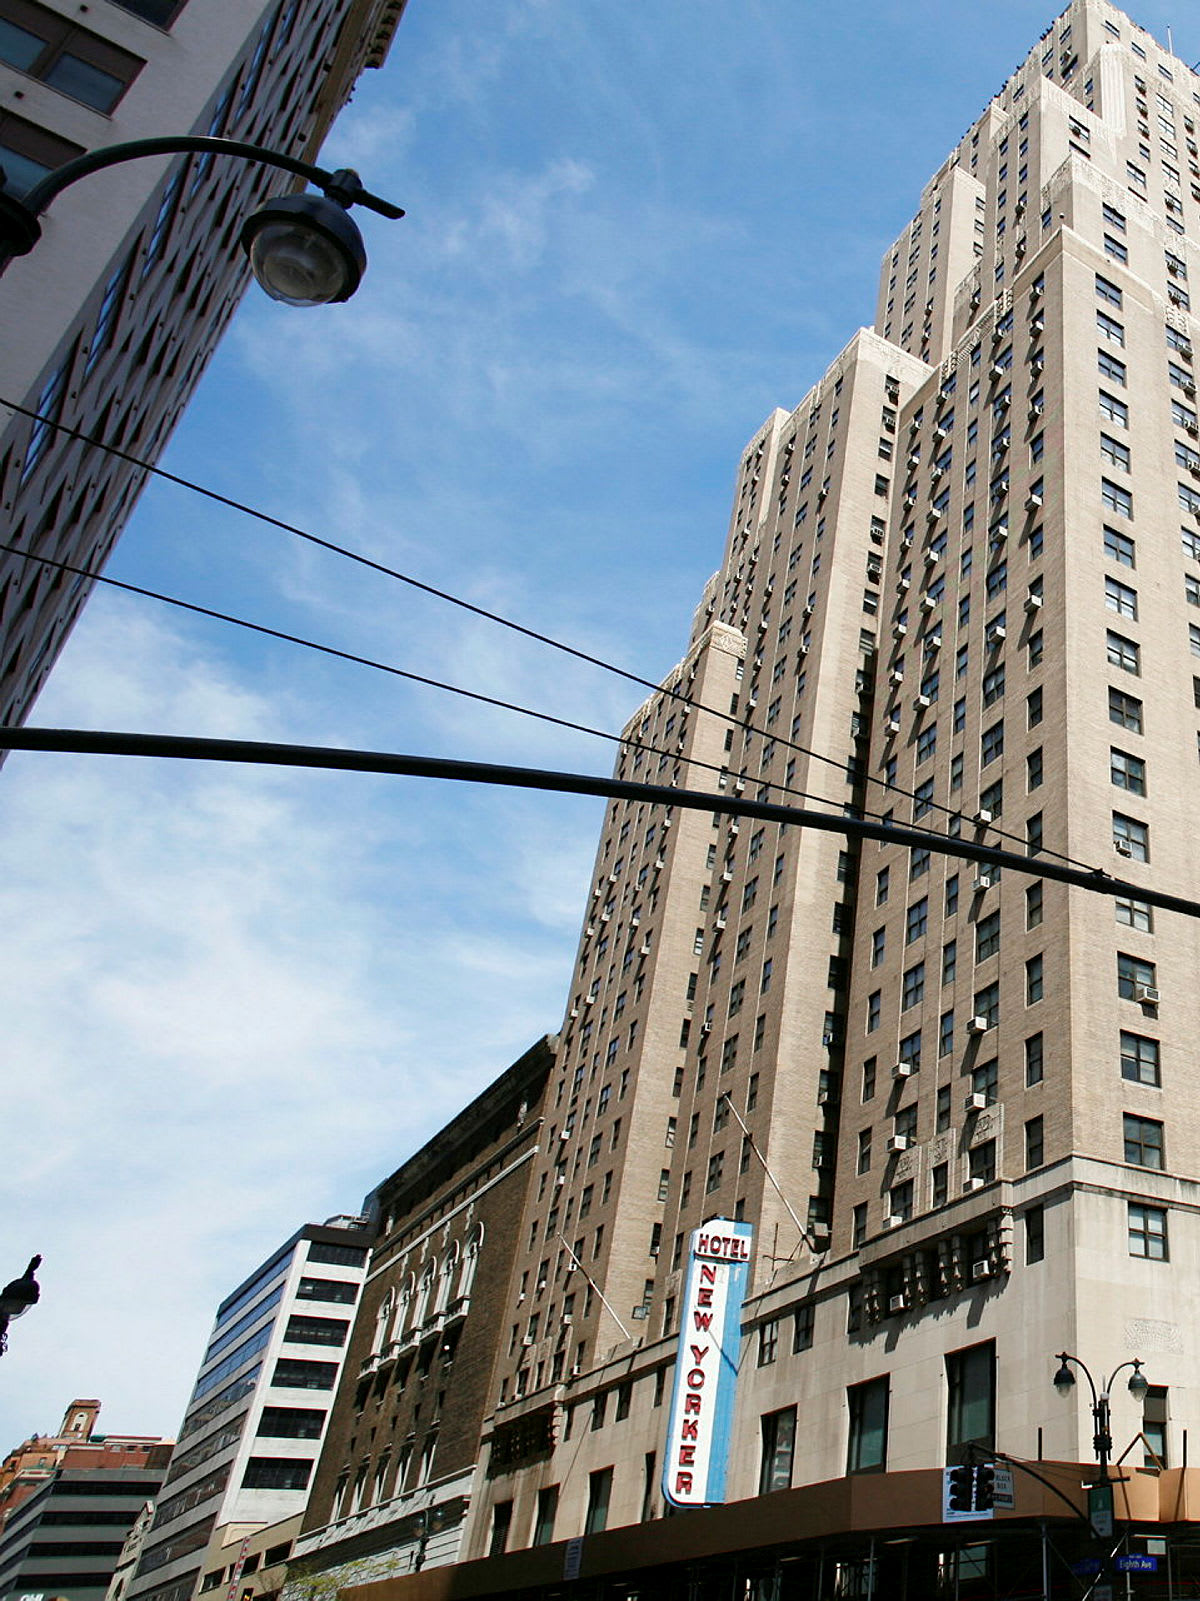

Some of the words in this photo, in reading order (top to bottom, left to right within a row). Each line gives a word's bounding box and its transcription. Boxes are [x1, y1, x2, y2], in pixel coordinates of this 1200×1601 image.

[697, 1233, 748, 1259] HOTEL
[693, 1264, 717, 1332] NEW
[675, 1344, 710, 1495] YORKER
[1119, 1560, 1140, 1571] Eighth
[1140, 1560, 1153, 1569] Ave
